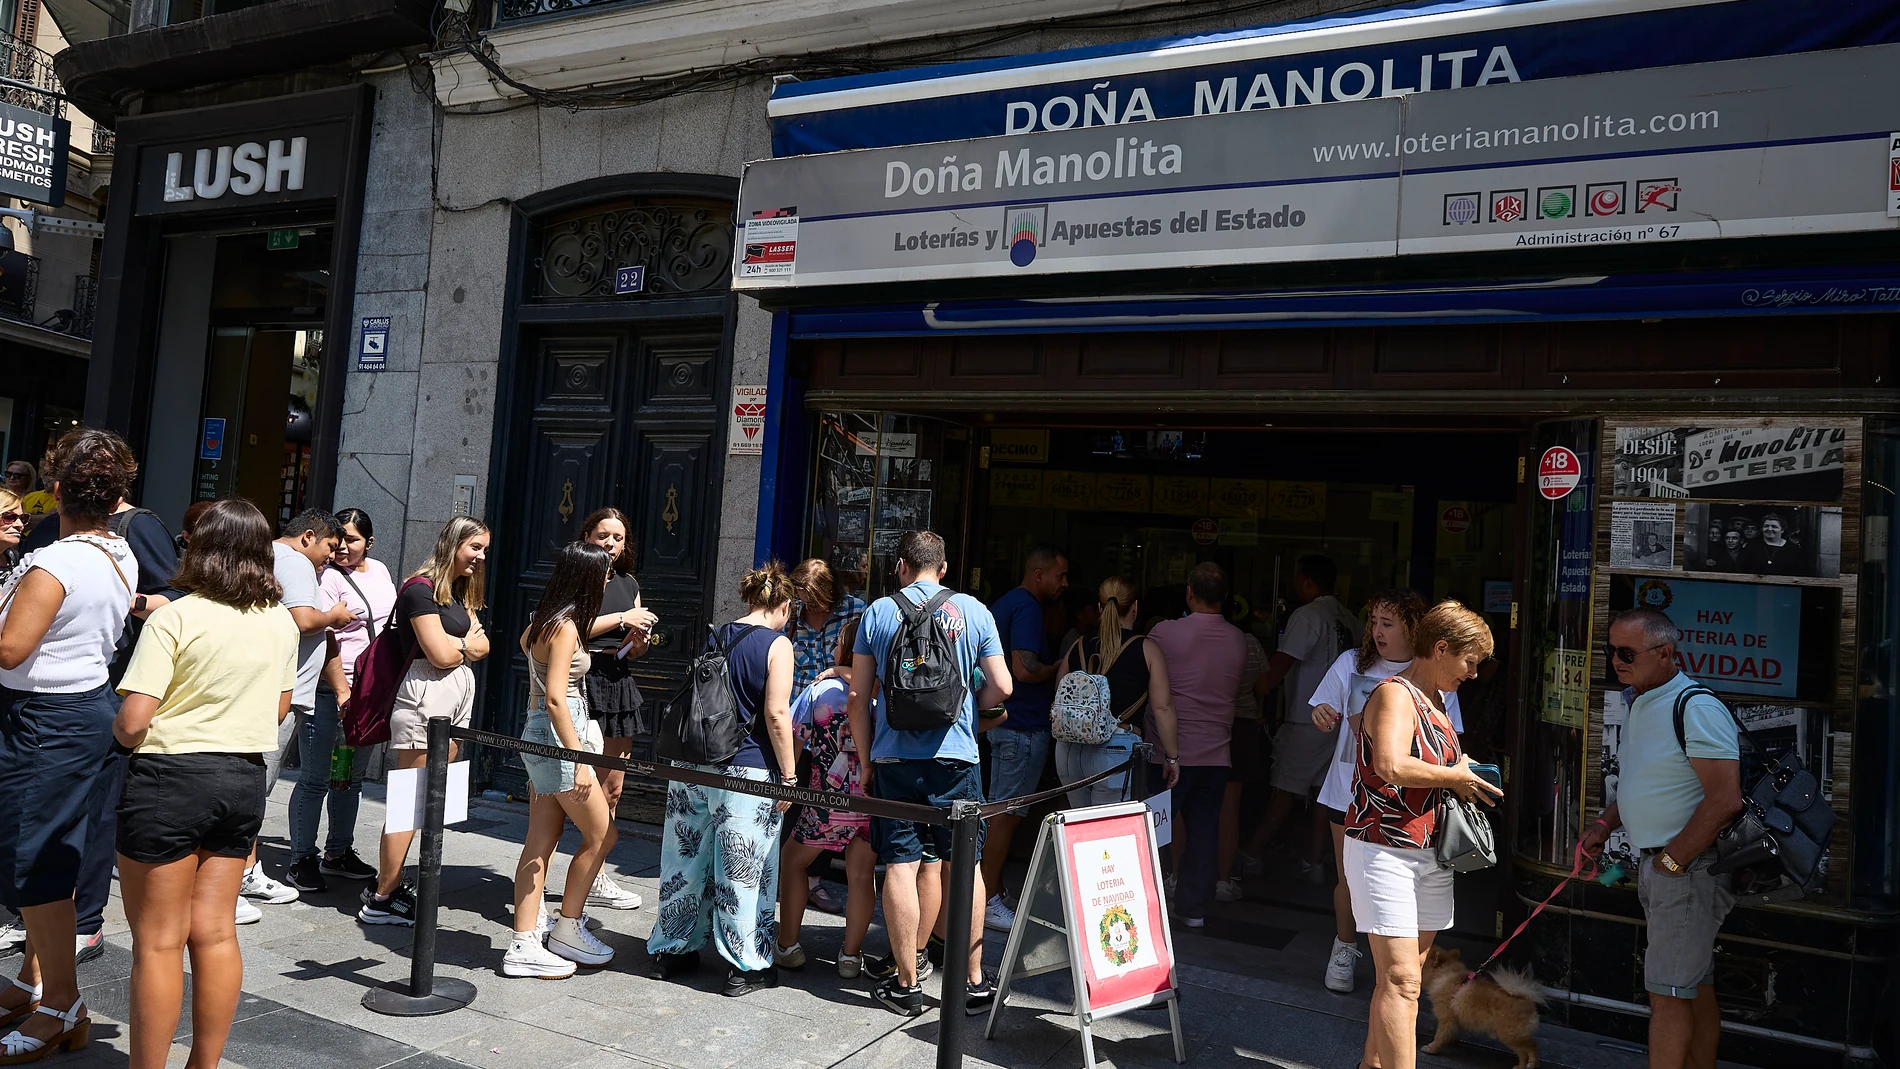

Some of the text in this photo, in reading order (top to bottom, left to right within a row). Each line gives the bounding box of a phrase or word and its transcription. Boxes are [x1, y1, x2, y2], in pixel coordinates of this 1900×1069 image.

[1004, 45, 1521, 136] DOÑA MANOLITA
[1312, 109, 1720, 163] www.loteriamanolita.com
[164, 136, 308, 203] LUSH
[884, 136, 1183, 198] Doña Manolita
[748, 220, 761, 228] ZONA
[894, 204, 1306, 252] Loterías y Apuestas del Estado
[1515, 227, 1632, 247] Administración
[1659, 225, 1681, 239] 67
[768, 245, 795, 253] LASSER
[746, 265, 761, 274] 24h
[620, 271, 638, 288] 22
[1623, 439, 1677, 455] DESDE
[1544, 452, 1569, 470] +18
[1686, 447, 1844, 484] LOTERIA
[1628, 466, 1668, 483] 1904
[1561, 582, 1587, 593] Estado
[1697, 609, 1734, 625] HAY
[1743, 633, 1768, 649] DE
[476, 733, 580, 760] WWW.LOTERIAMANOLITA.COM
[723, 777, 850, 808] WWW.LOTERIAMANOLITA.COM
[1101, 863, 1115, 875] HAY
[1096, 876, 1125, 891] LOTERIA
[1091, 890, 1135, 907] DE NAVIDAD
